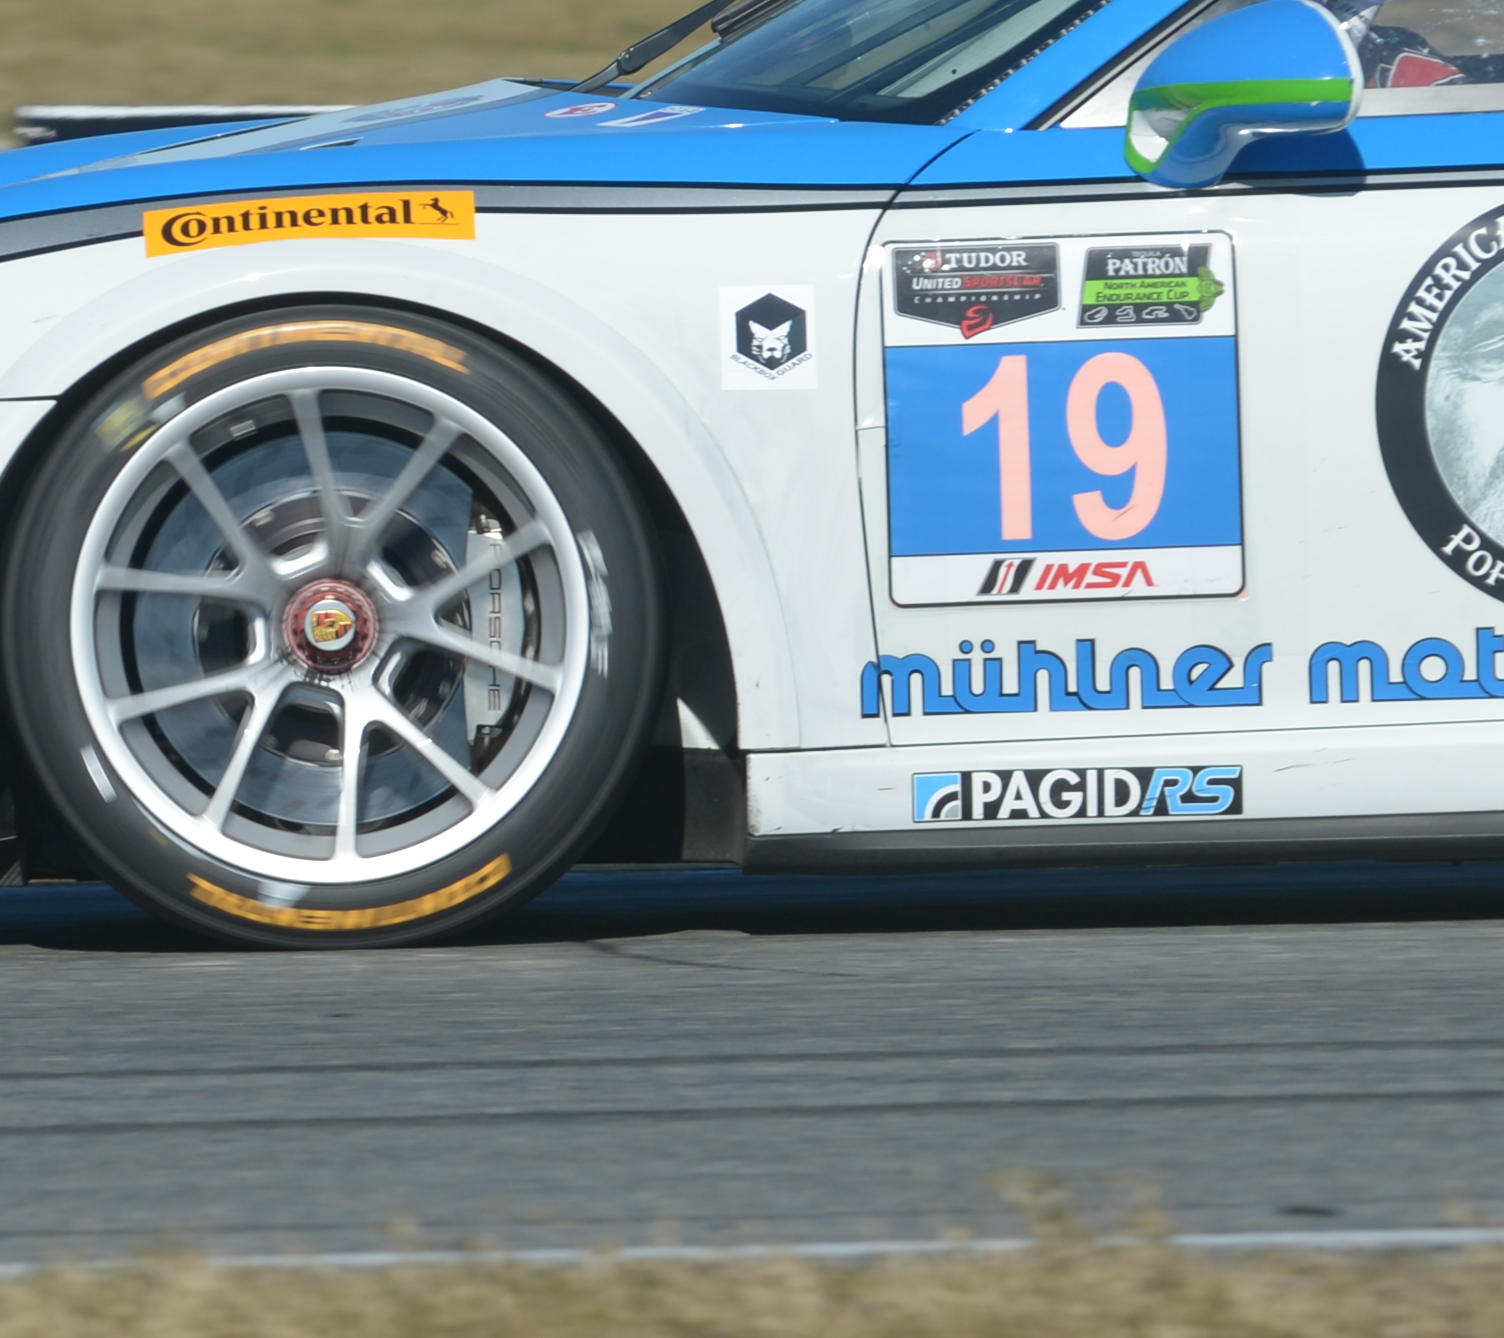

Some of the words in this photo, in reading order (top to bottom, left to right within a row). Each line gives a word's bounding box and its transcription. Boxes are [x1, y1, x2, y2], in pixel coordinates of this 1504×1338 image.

[160, 198, 415, 247] Continental
[946, 251, 1027, 268] TUDOR
[912, 277, 961, 289] UNITED
[1104, 281, 1137, 291] NORTH
[1140, 280, 1187, 289] AMERICAN
[1096, 291, 1163, 302] ENDURANCE
[1166, 289, 1189, 300] CUP
[776, 353, 813, 376] GUARD
[962, 352, 1167, 540] 19
[1034, 560, 1155, 589] IMSA
[861, 638, 1273, 718] mühlner
